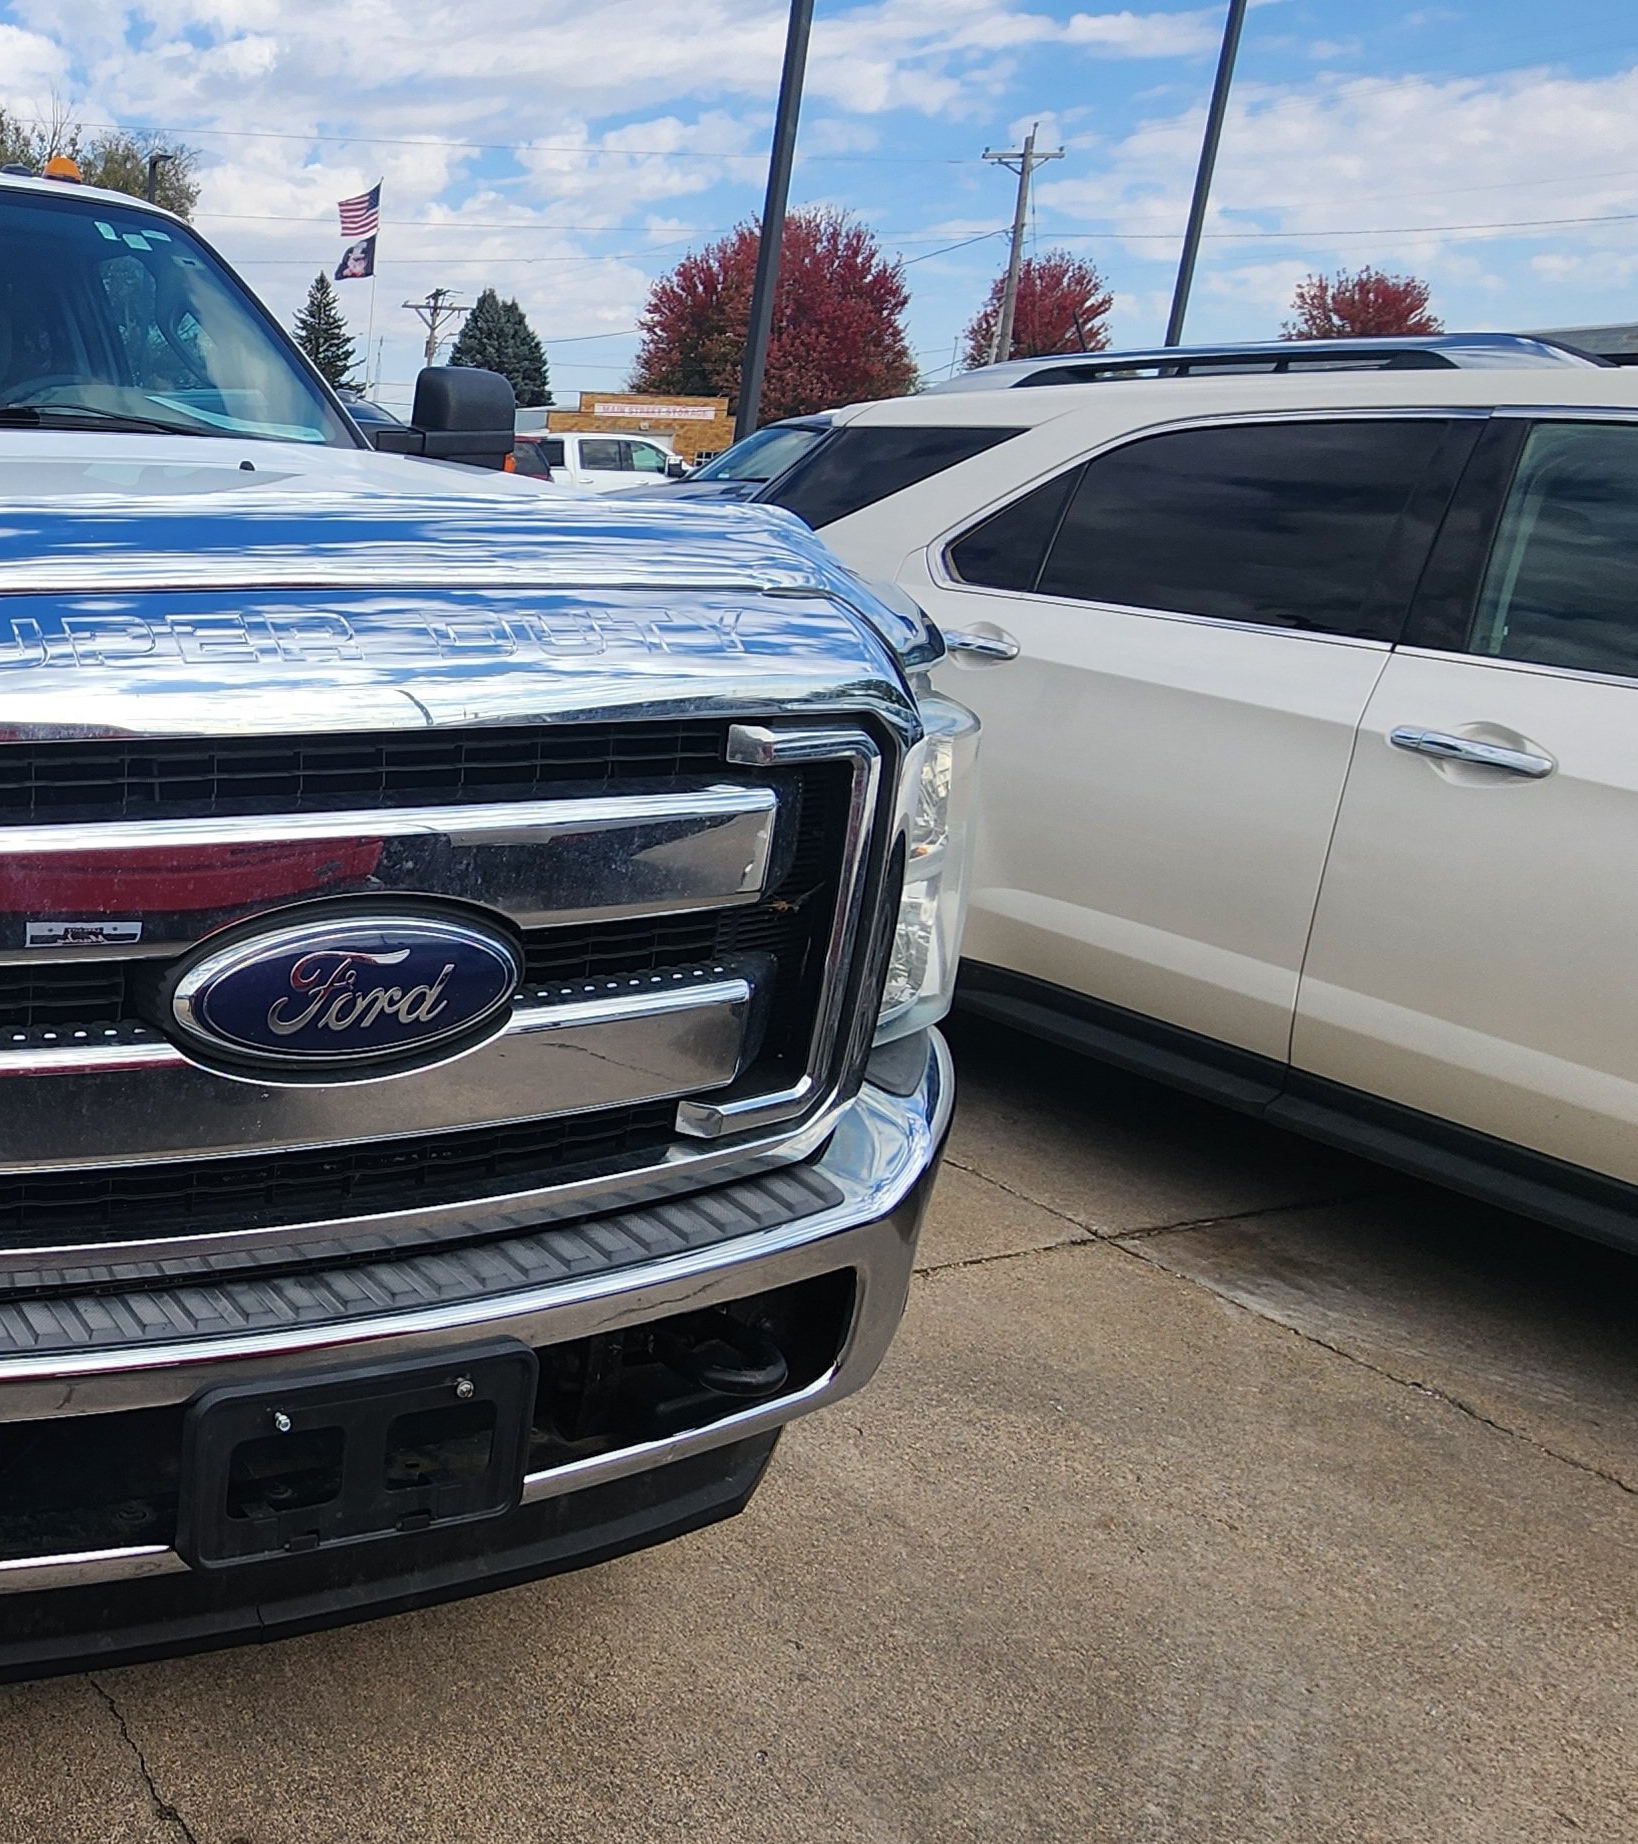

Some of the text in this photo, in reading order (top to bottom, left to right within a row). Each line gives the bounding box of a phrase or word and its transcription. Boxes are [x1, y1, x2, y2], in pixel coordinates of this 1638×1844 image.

[602, 405, 707, 418] MAIN STREET STORAGE
[418, 608, 746, 660] DUTY
[267, 949, 455, 1035] Ford
